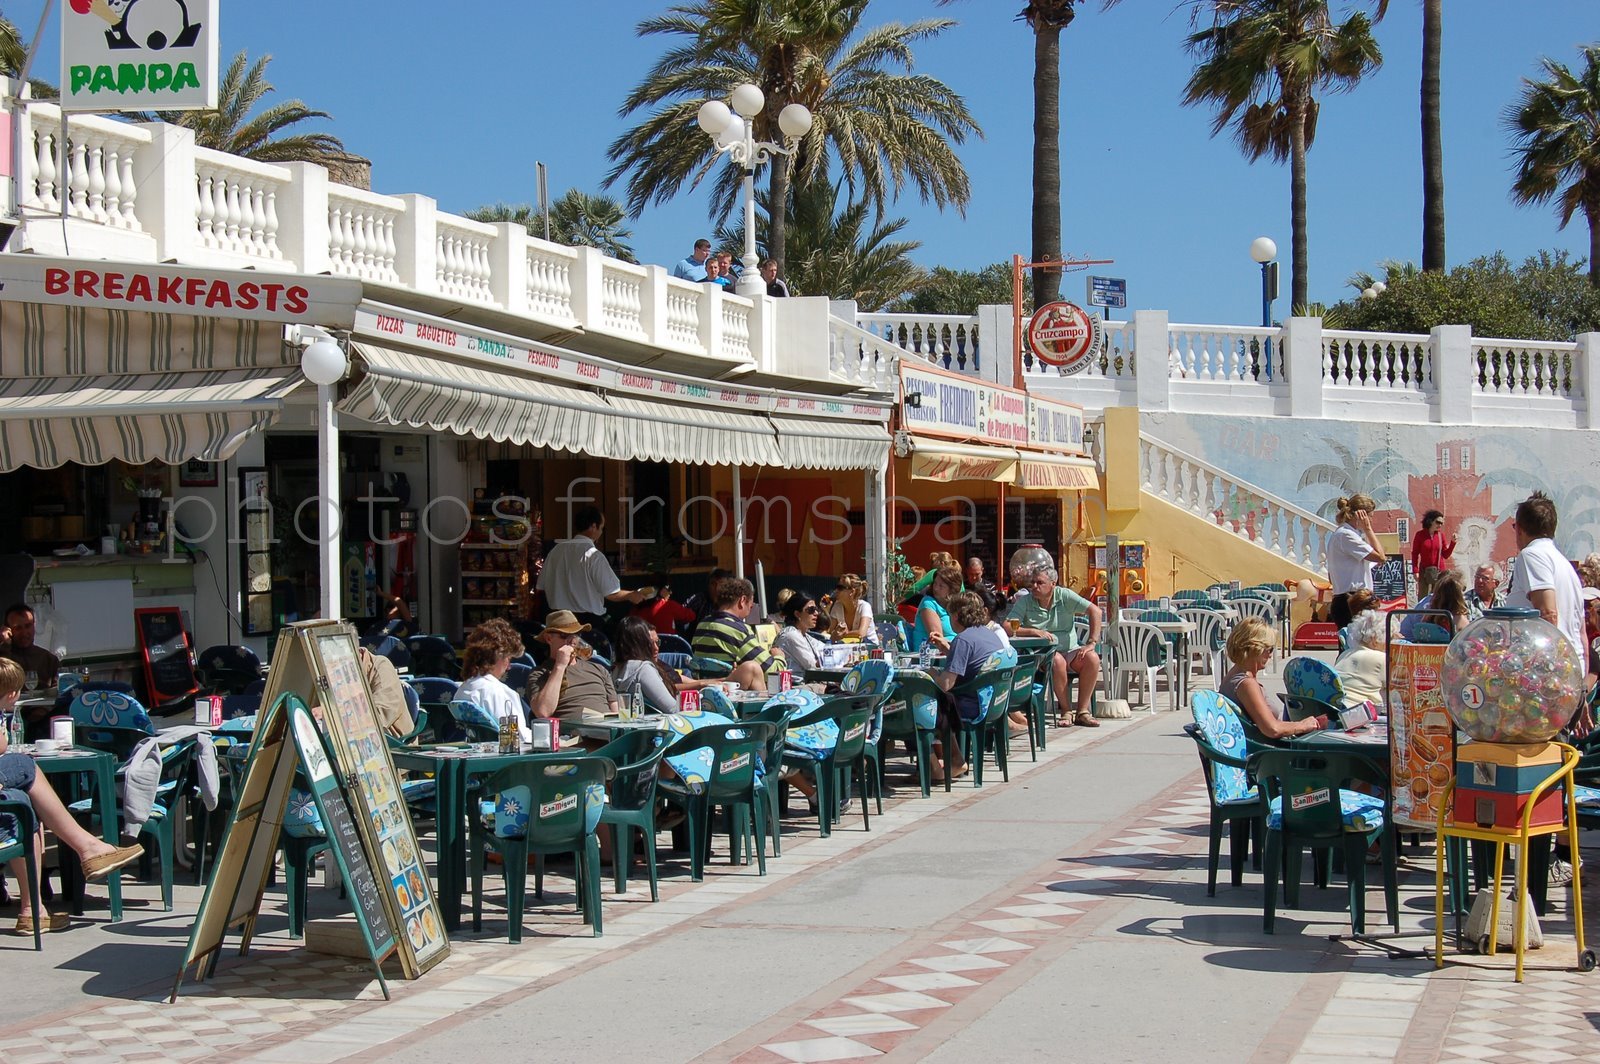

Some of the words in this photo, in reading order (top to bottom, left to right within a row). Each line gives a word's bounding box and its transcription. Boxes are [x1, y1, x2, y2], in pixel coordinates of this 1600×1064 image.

[70, 62, 201, 95] PANDA
[45, 268, 309, 315] BREAKFASTS
[376, 314, 405, 335] PIZZAS
[416, 322, 457, 347] BAGUETTES
[1035, 328, 1084, 340] Cruzcampo
[477, 337, 507, 358] PANDA
[527, 349, 560, 369] PESCAITOS
[576, 361, 600, 379] PAELLAS
[906, 377, 937, 398] PESCADOS
[939, 384, 977, 428] FREIDURIA
[987, 418, 994, 437] de
[1023, 463, 1052, 487] MARINA
[1470, 688, 1479, 704] 1
